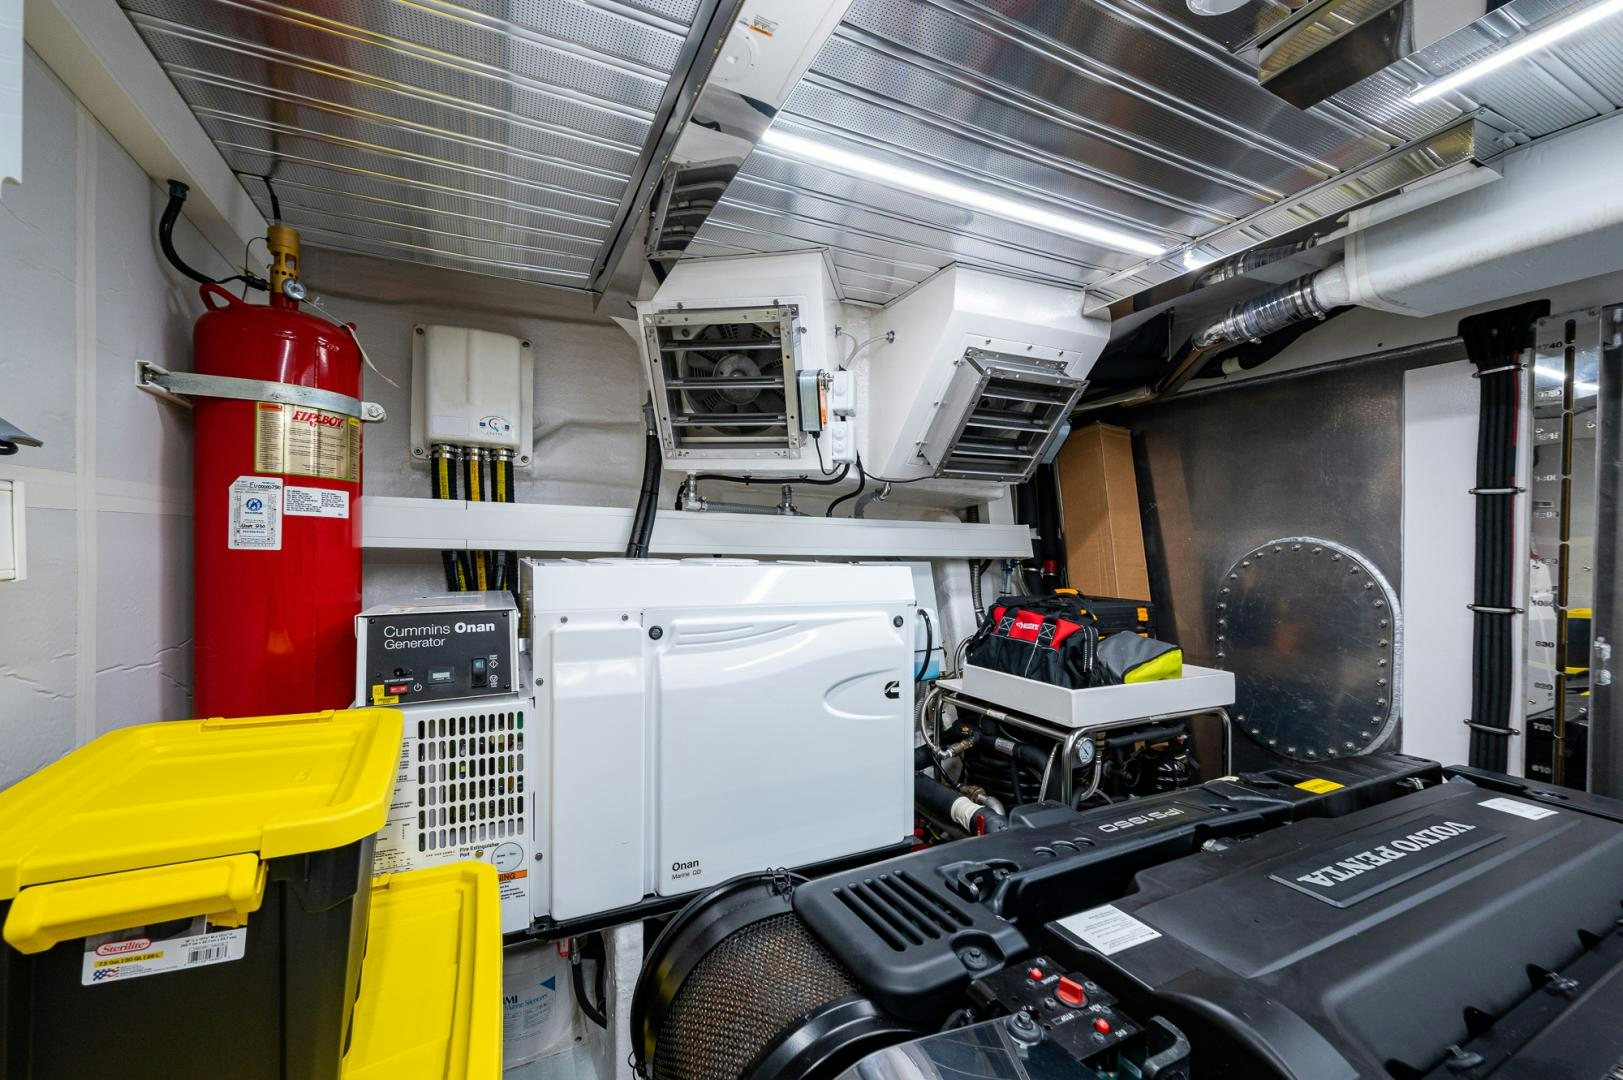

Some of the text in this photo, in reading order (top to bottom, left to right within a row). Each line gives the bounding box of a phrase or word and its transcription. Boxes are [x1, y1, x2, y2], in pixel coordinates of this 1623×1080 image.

[384, 622, 495, 638] Cummins Onan
[384, 637, 445, 650] Generator
[470, 842, 500, 850] Extinguisher
[1296, 821, 1477, 888] VOLVO PENTA
[672, 860, 699, 871] Onan
[101, 941, 148, 954] Sterilite
